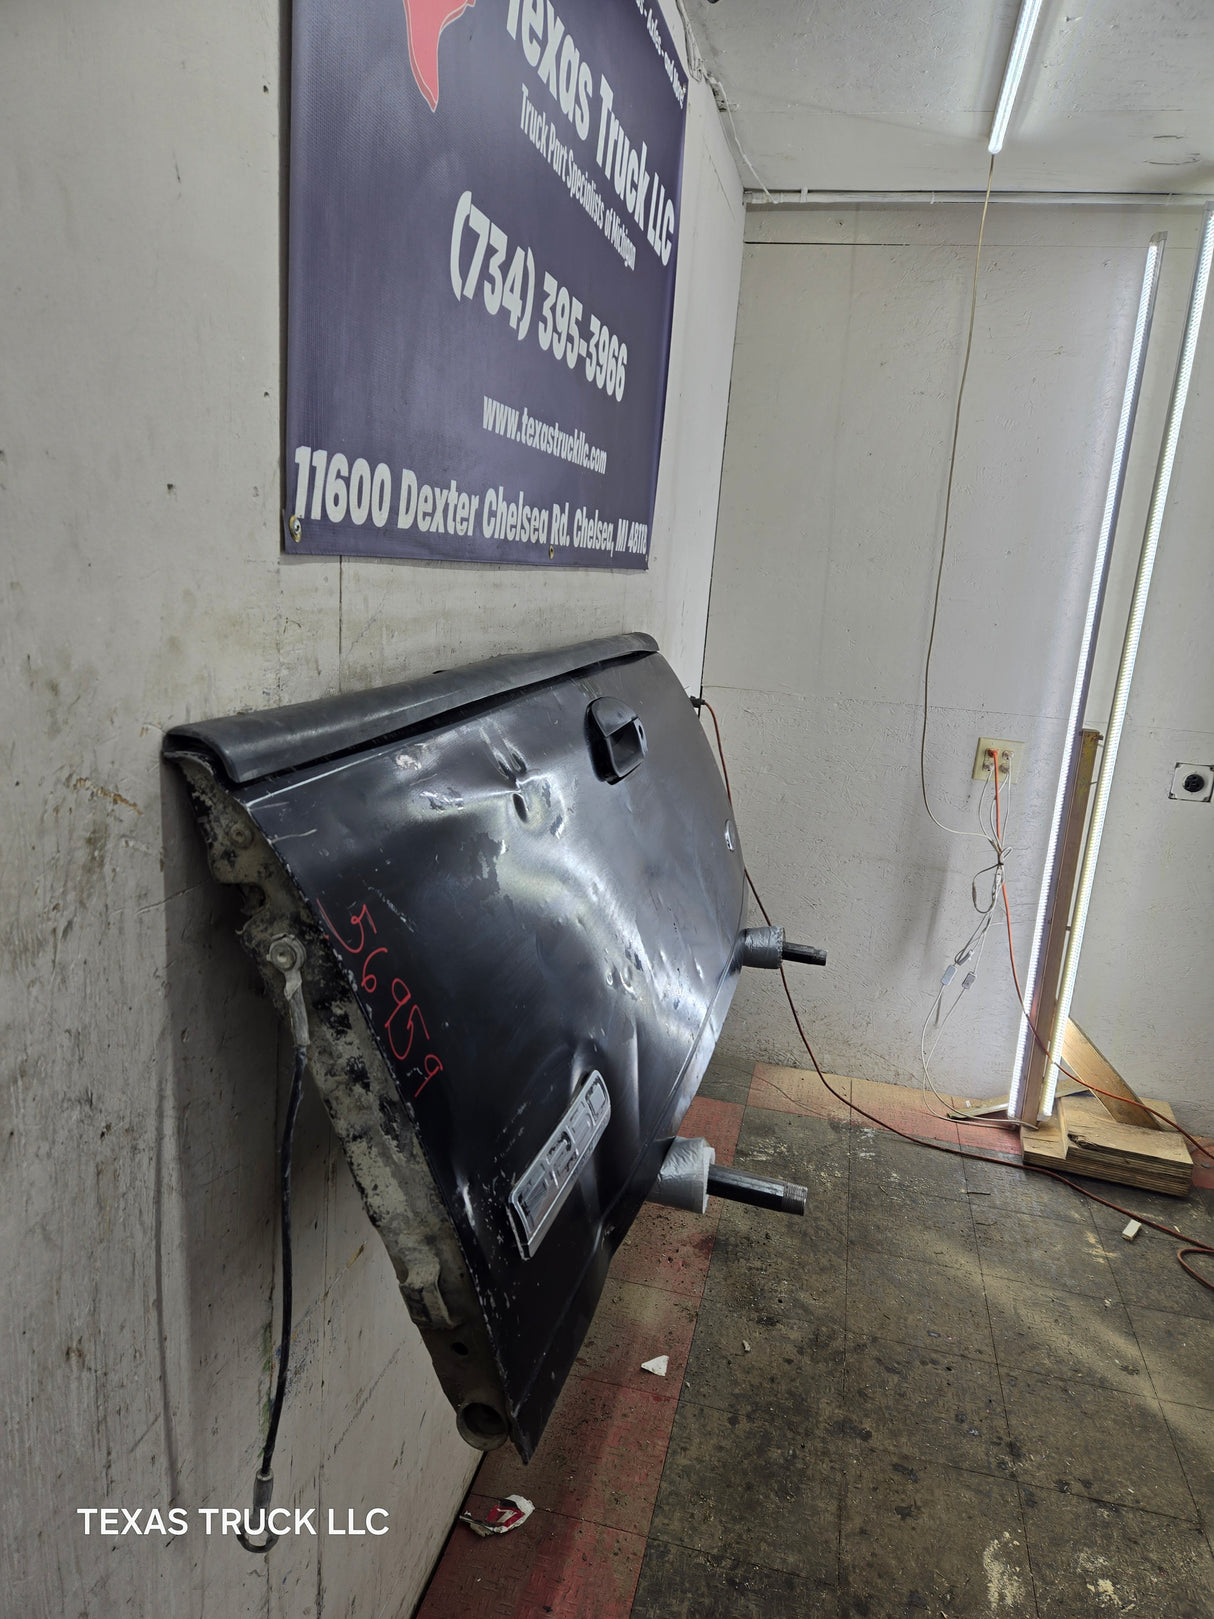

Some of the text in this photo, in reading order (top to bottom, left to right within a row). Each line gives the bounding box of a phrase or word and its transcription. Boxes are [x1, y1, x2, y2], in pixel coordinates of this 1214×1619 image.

[520, 82, 549, 158] Truck
[548, 121, 568, 182] Part
[567, 148, 604, 229] Specialists
[604, 207, 614, 240] of
[596, 73, 650, 231] Truck
[647, 172, 675, 267] LLC
[450, 190, 628, 402] (734) 395-3966
[294, 445, 392, 528] 11600
[397, 468, 479, 537] Dexter
[482, 486, 549, 544] Chelsea
[551, 502, 570, 547] Rd.
[573, 506, 614, 558] Chelsea,
[615, 518, 629, 552] MI
[482, 395, 607, 475] www.texastruckllc.com
